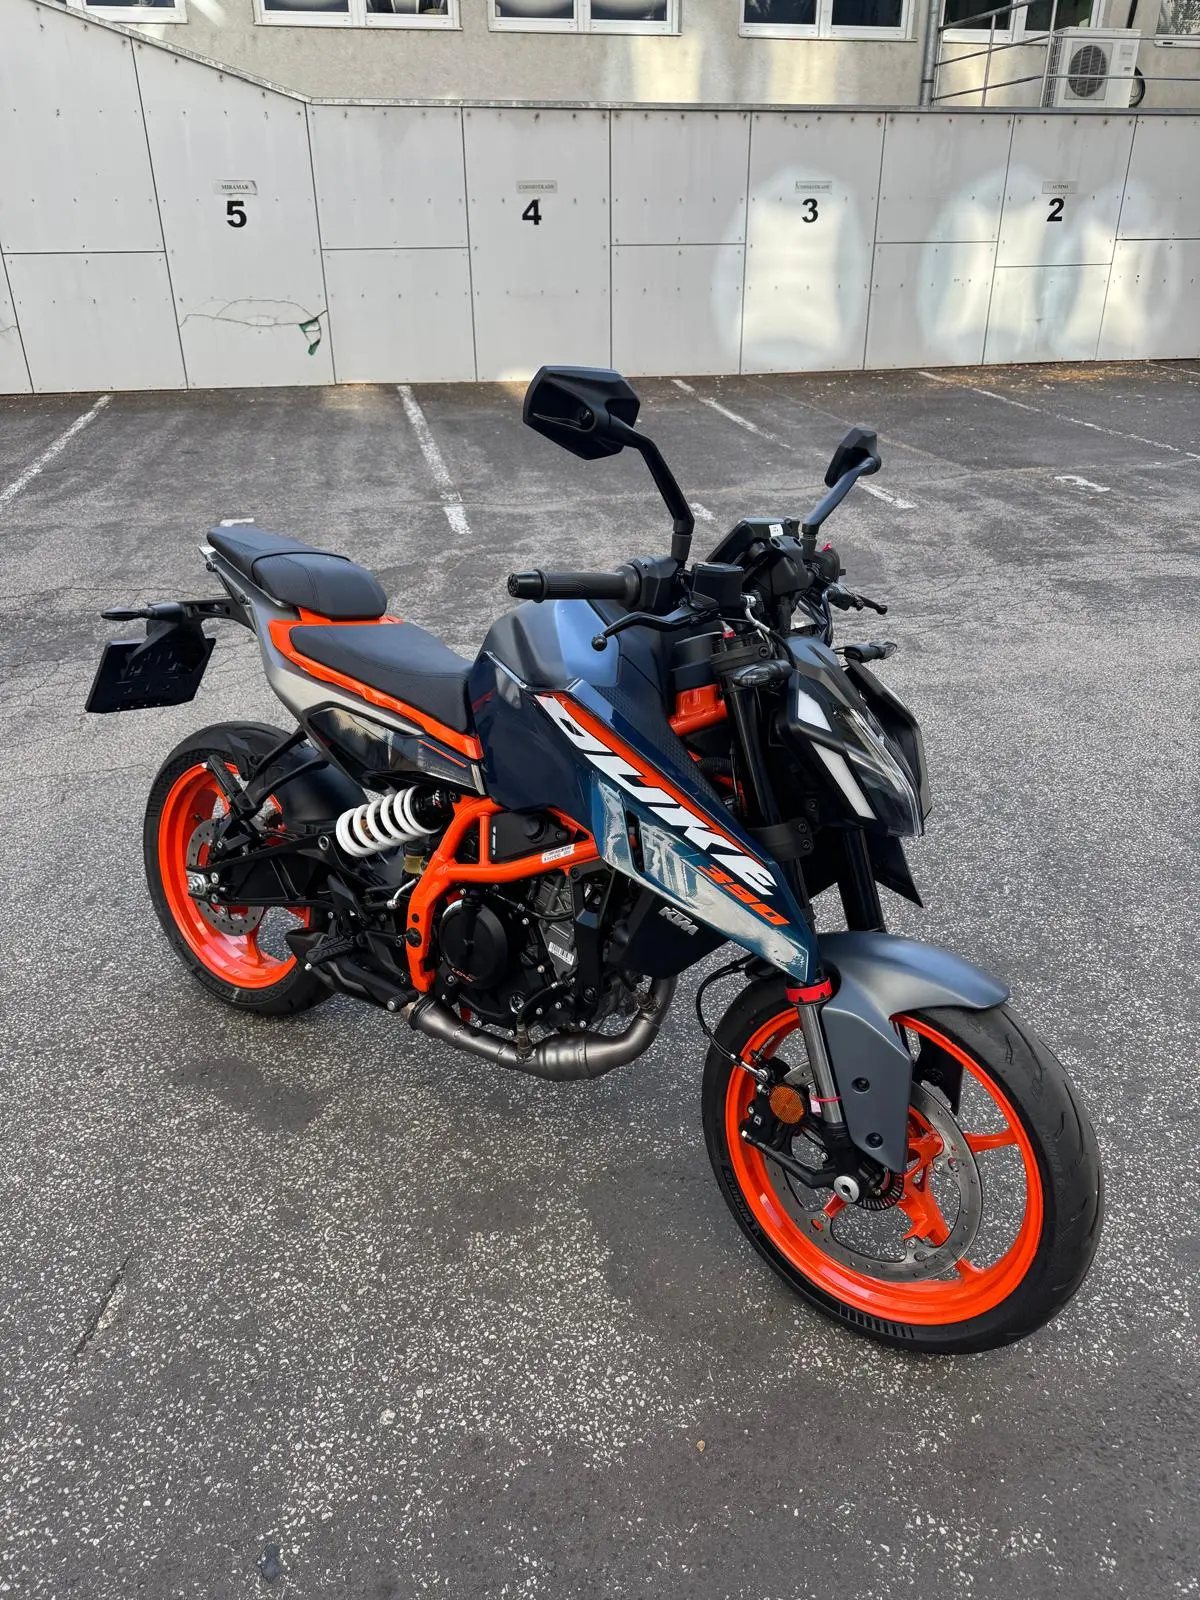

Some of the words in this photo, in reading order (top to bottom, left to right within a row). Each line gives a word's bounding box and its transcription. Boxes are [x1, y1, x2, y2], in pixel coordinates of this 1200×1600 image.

[226, 200, 247, 228] 5
[522, 199, 542, 226] 4
[802, 198, 819, 223] 3
[1046, 198, 1065, 222] 2
[535, 694, 778, 896] DUKE
[696, 864, 790, 926] 390
[658, 906, 700, 936] KTM
